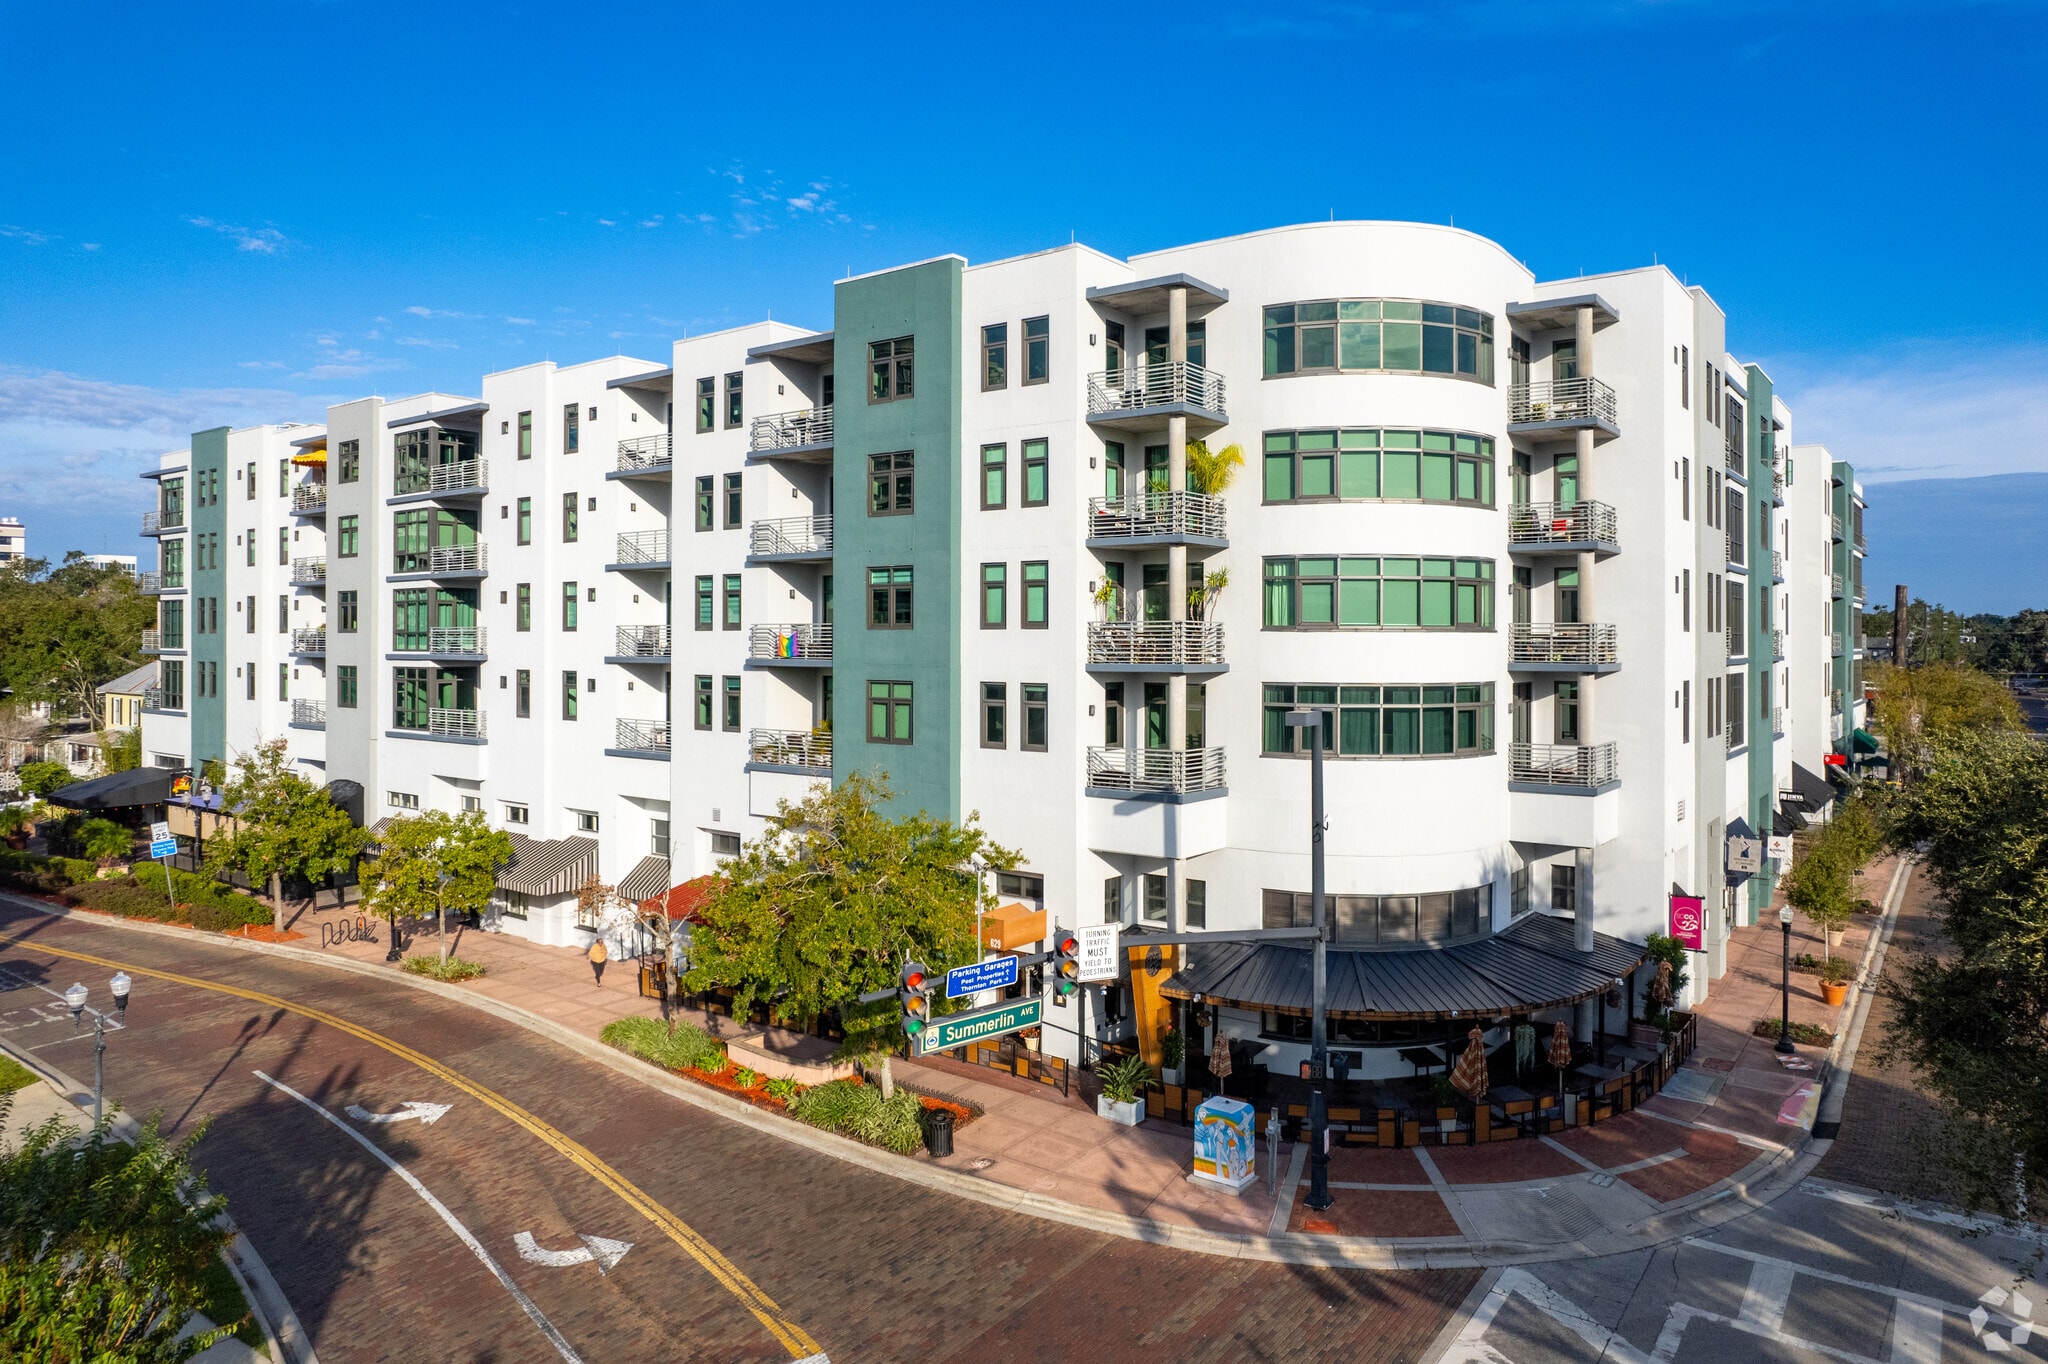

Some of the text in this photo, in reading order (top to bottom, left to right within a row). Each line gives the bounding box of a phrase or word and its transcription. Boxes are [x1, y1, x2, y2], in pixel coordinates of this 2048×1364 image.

[155, 832, 168, 840] 25
[1085, 929, 1111, 938] TURNING
[990, 937, 1002, 949] 629
[1086, 937, 1110, 947] TRAFFIC
[1087, 946, 1108, 957] MUST
[1084, 957, 1112, 967] YIELD TO
[952, 960, 1014, 979] Parking Garages
[1079, 966, 1116, 977] PEDESTRIANS
[960, 971, 1005, 985] Post Properties
[960, 978, 1003, 992] Thornton Park
[946, 1006, 1034, 1041] Summerlin AVE
